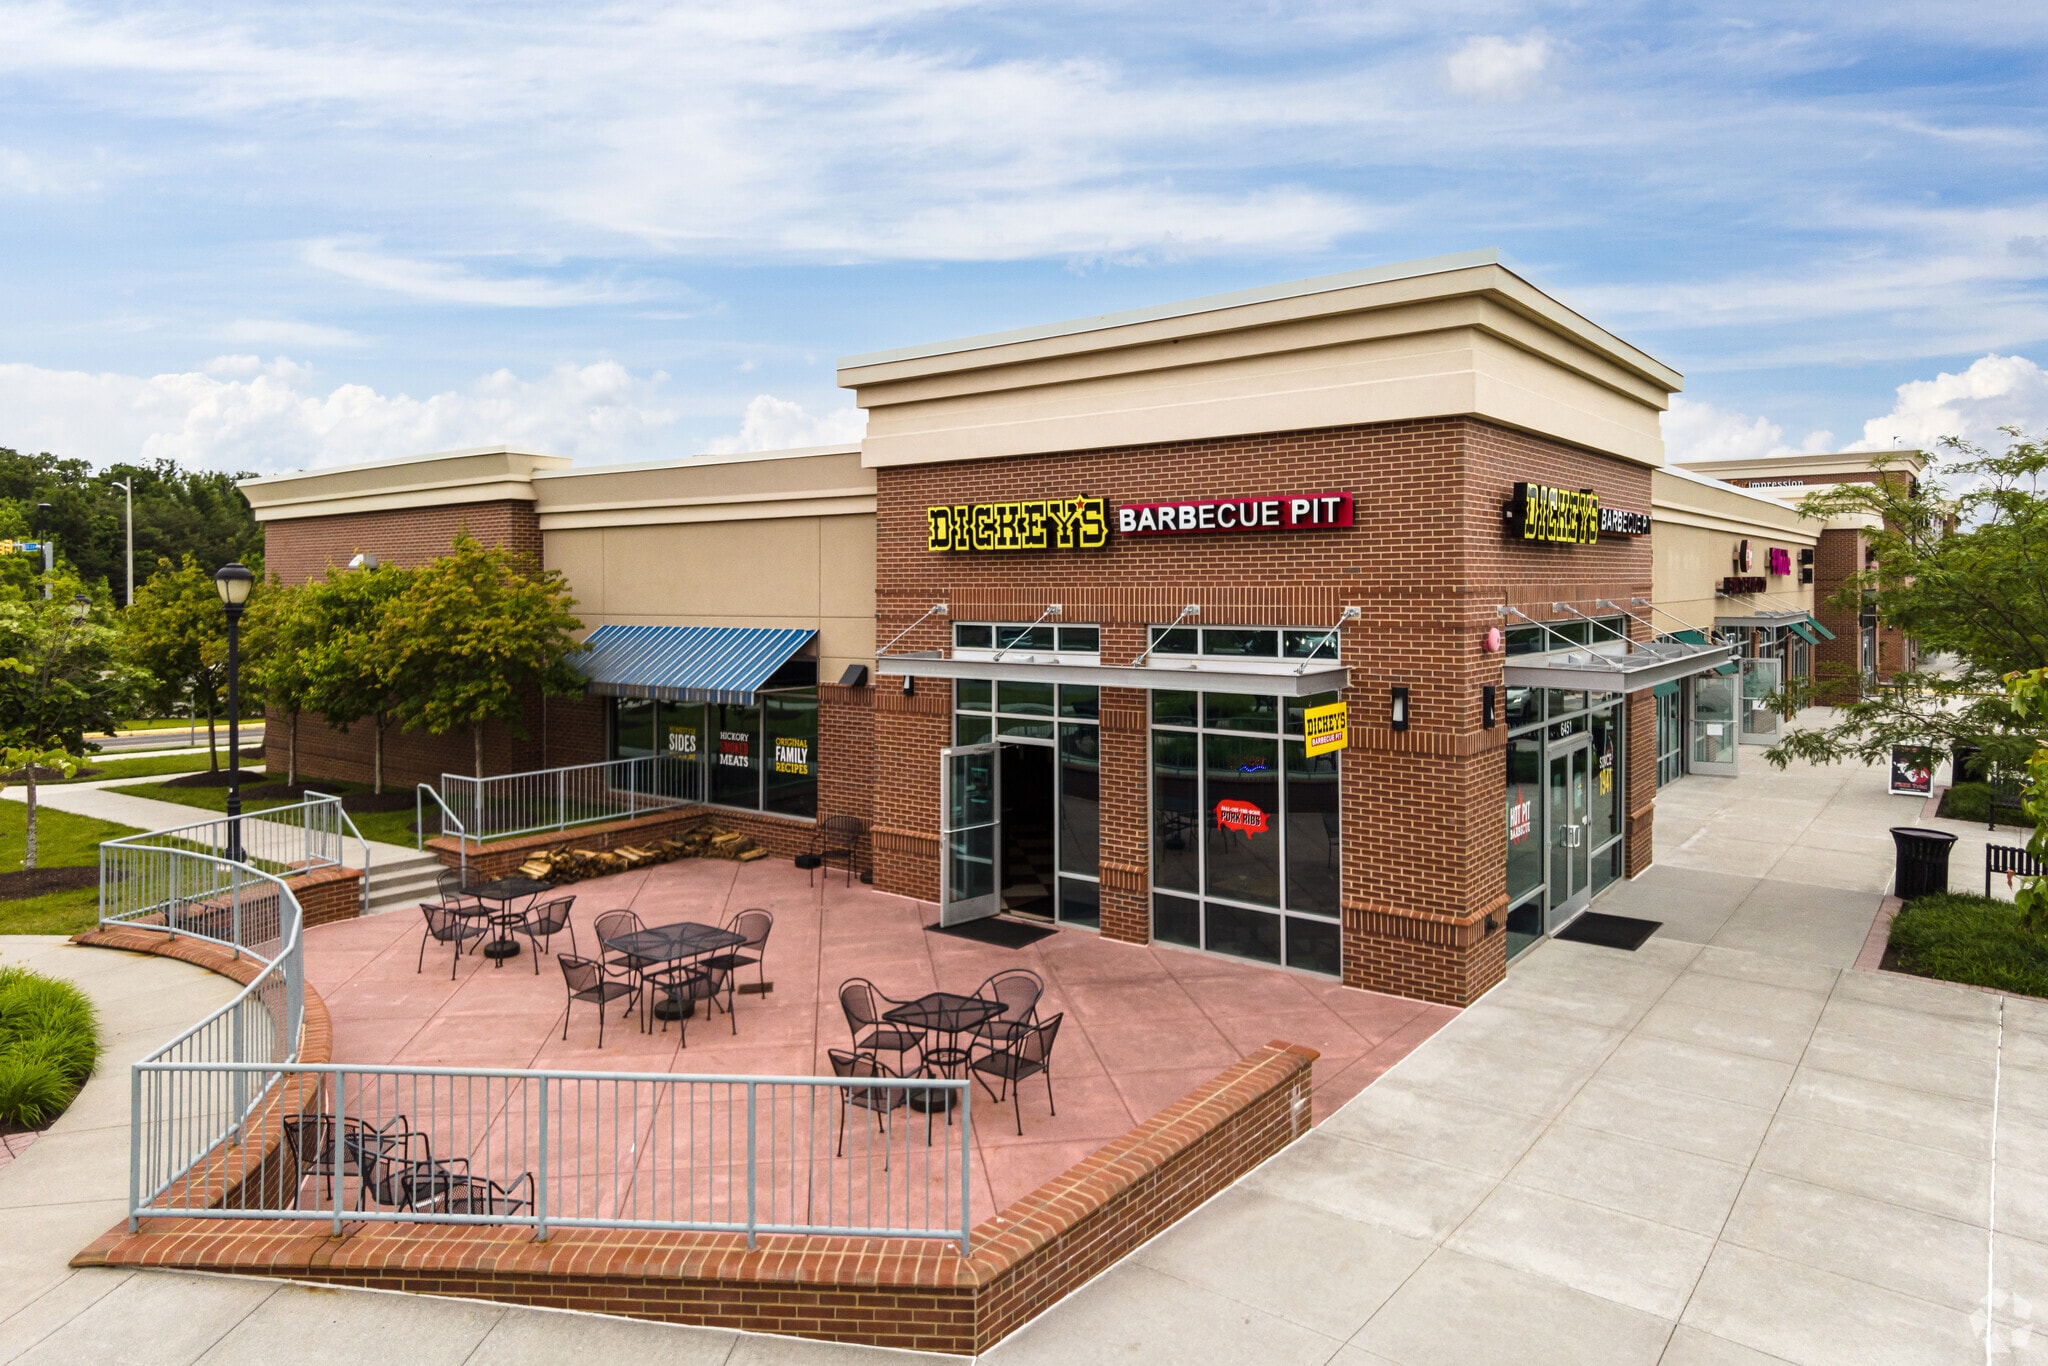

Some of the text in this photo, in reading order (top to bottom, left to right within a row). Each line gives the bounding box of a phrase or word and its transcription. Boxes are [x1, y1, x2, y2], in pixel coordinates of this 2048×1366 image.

[1119, 501, 1280, 532] BARBECUE
[1291, 497, 1341, 525] PIT
[1601, 508, 1641, 534] BARBECUE
[720, 731, 749, 742] HICKORY
[1560, 720, 1572, 737] 6451
[669, 732, 696, 752] SIDES
[775, 737, 808, 748] ORIGINAL
[720, 753, 749, 767] MEATS
[775, 745, 808, 764] FAMILY
[775, 761, 808, 775] RECIPES
[1221, 810, 1261, 827] PORK RIBS
